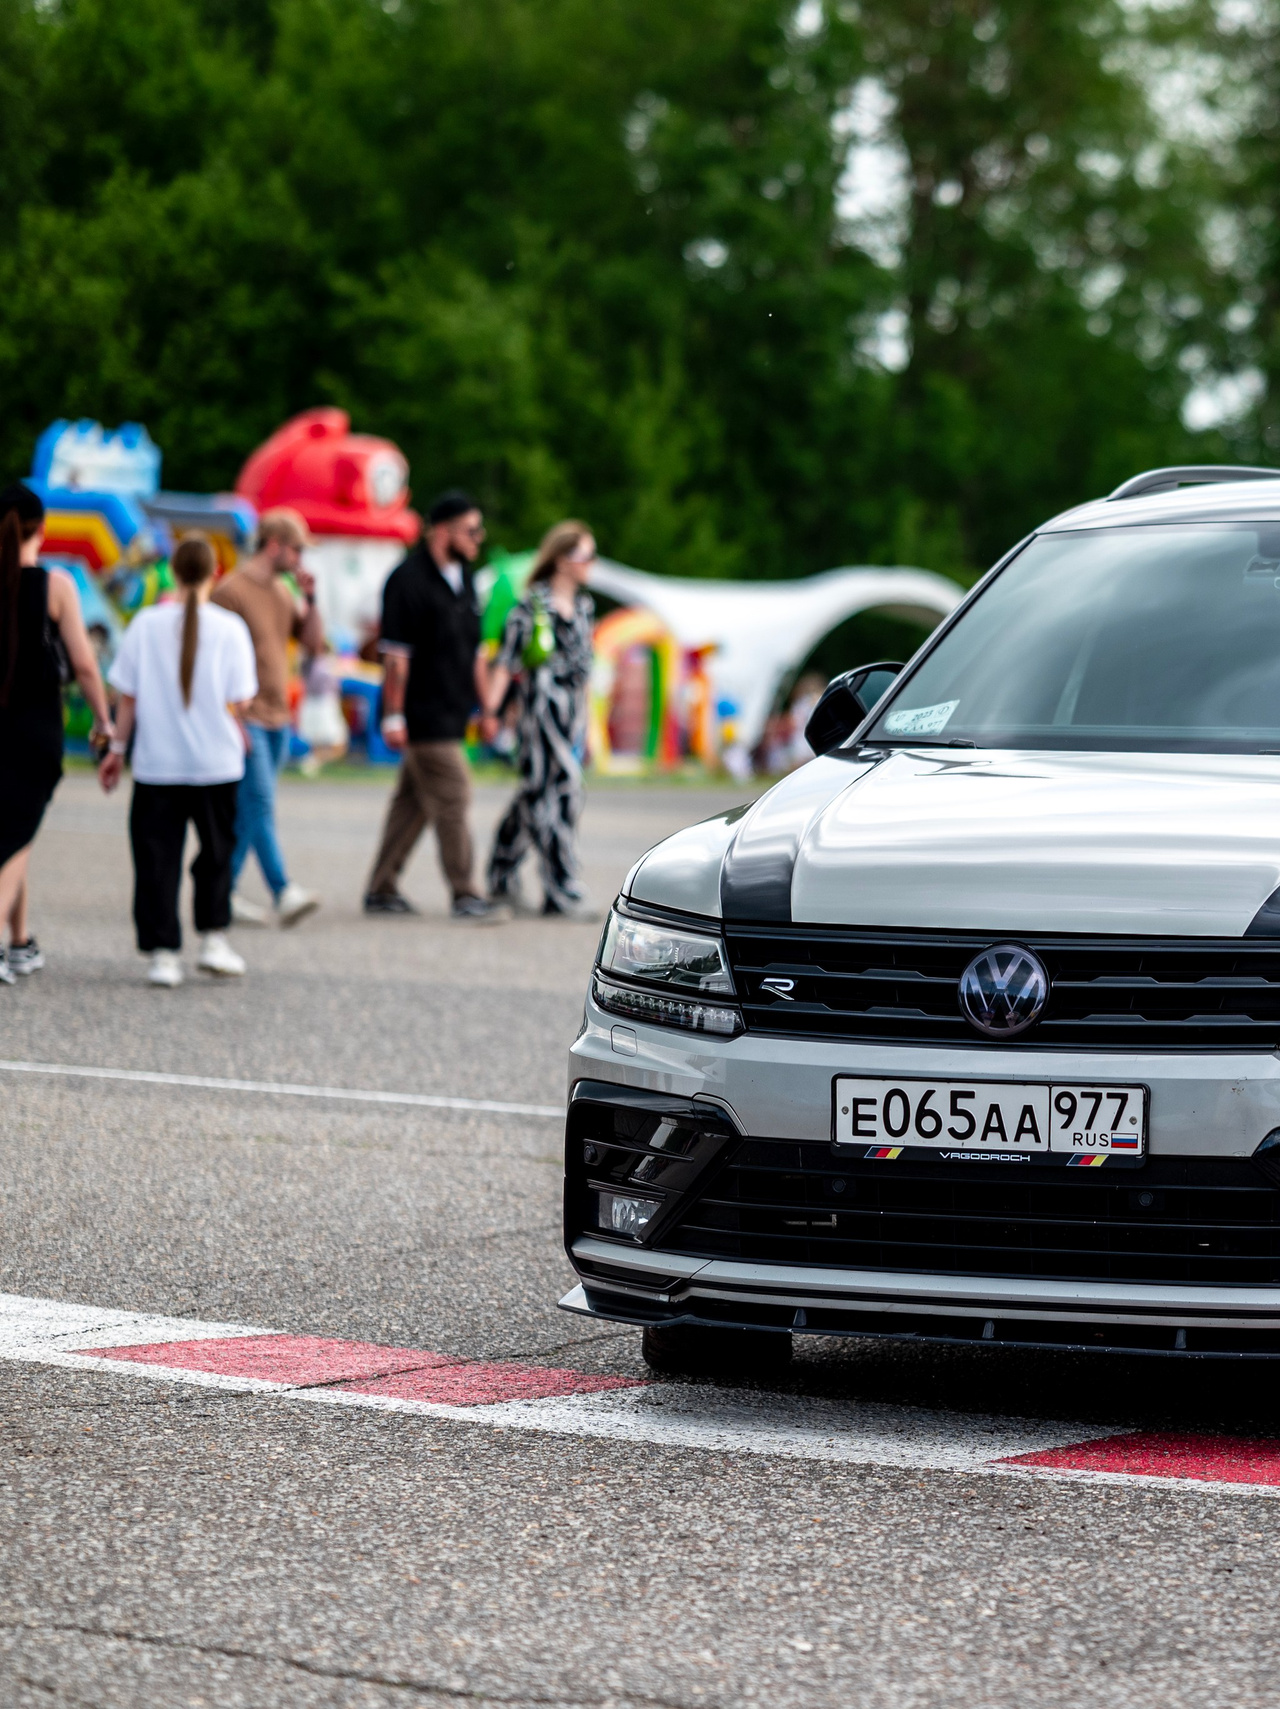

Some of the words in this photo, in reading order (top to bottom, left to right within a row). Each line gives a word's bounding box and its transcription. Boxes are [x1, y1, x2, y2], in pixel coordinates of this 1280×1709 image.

[760, 977, 795, 1001] R
[851, 1087, 1042, 1144] E065AA
[1054, 1090, 1130, 1131] 977
[1072, 1133, 1110, 1148] RUS
[939, 1152, 1031, 1162] VAGODROCH
